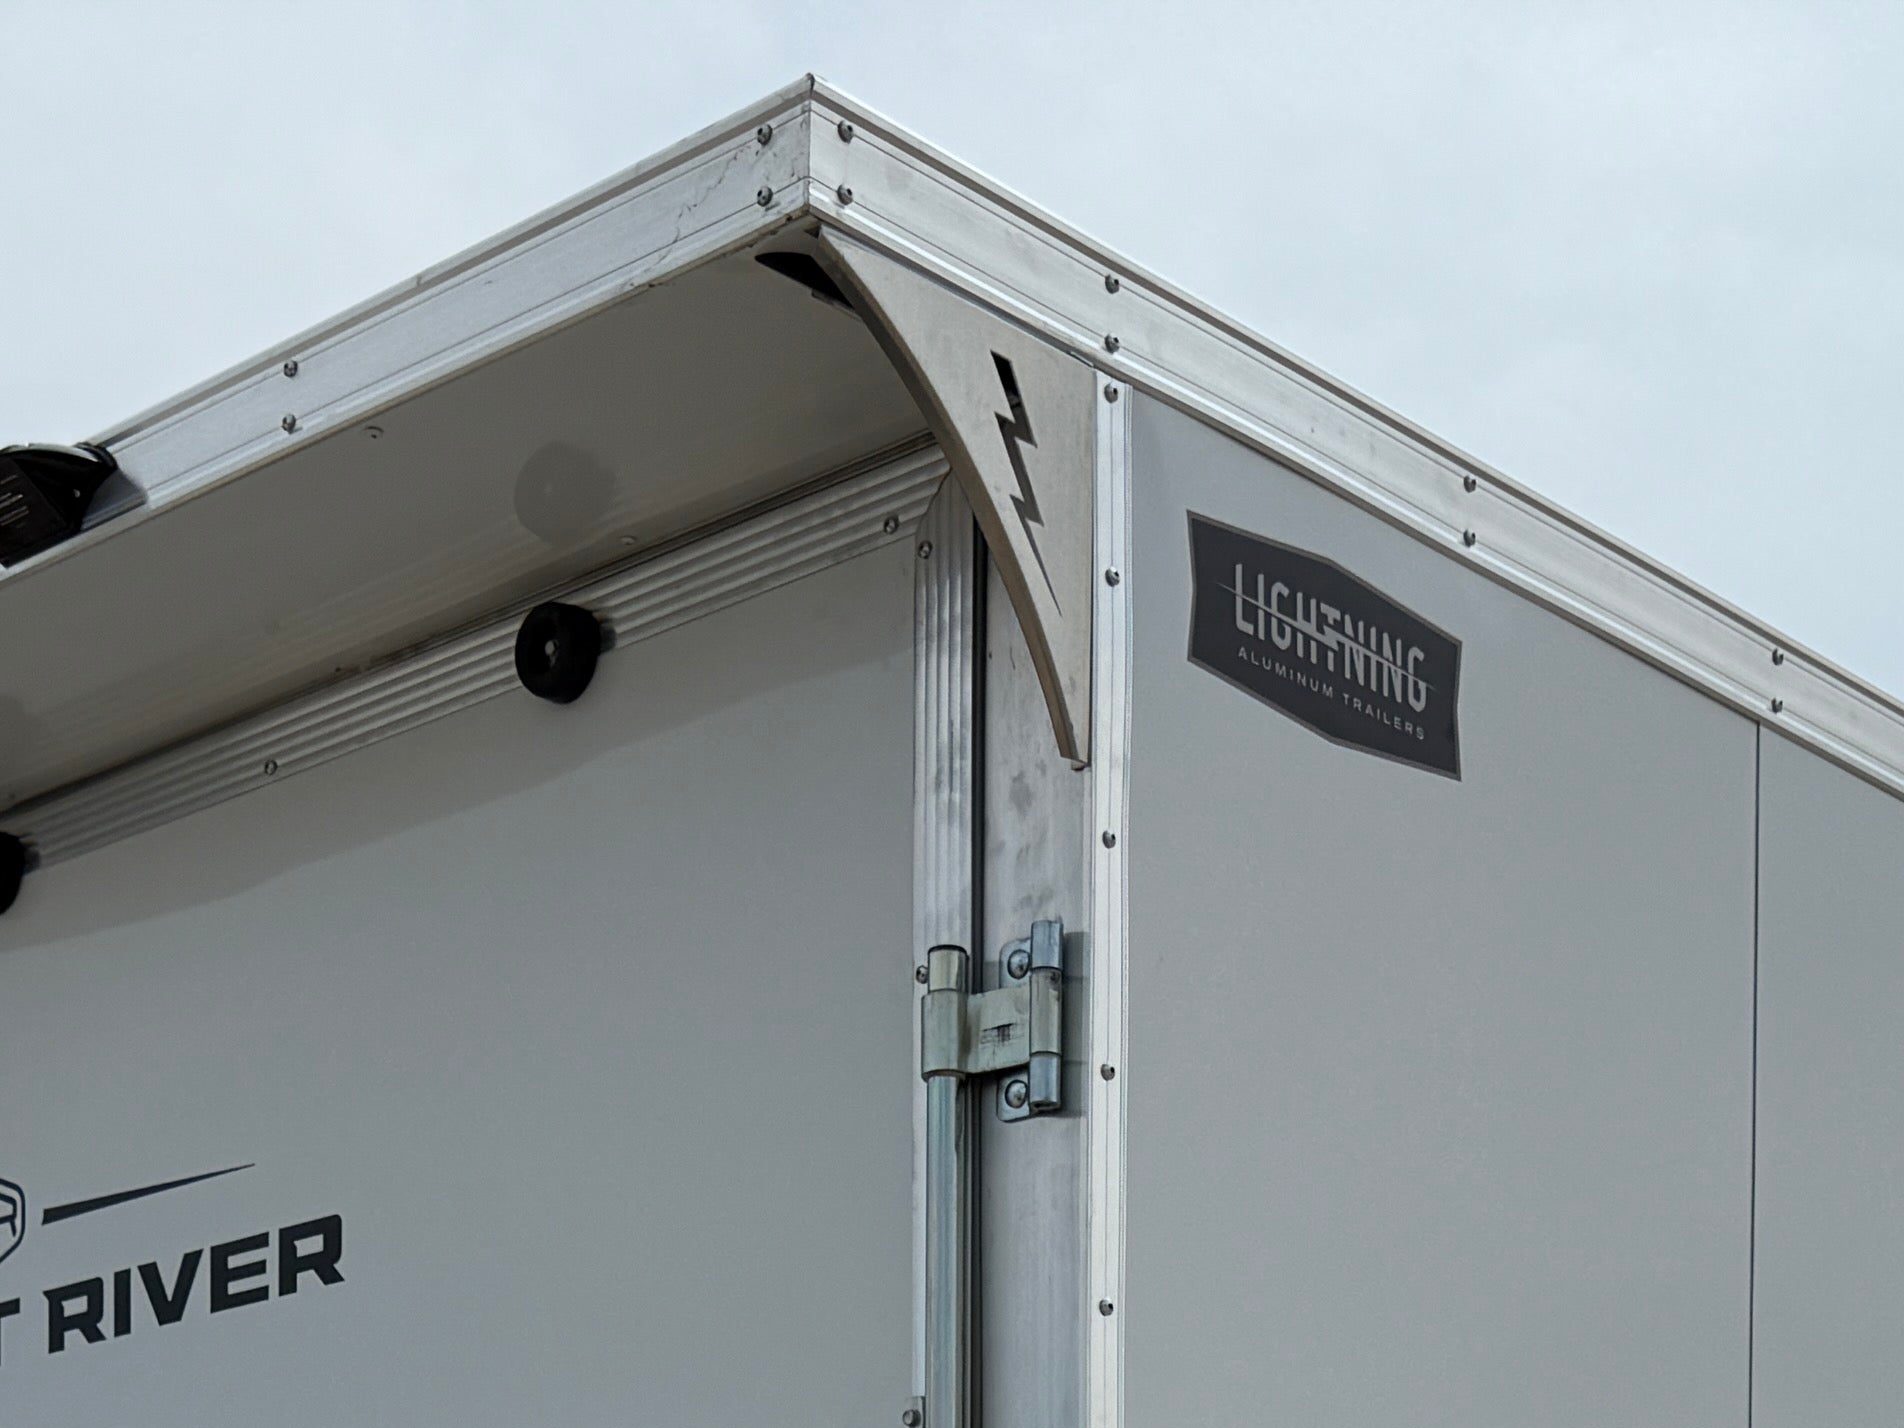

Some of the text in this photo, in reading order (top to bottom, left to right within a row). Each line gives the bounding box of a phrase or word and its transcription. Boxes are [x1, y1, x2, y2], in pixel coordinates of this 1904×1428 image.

[1234, 563, 1428, 713] LIGHTNING
[1238, 646, 1425, 741] ALUMINUM TRAILERS
[43, 1213, 346, 1354] RIVER
